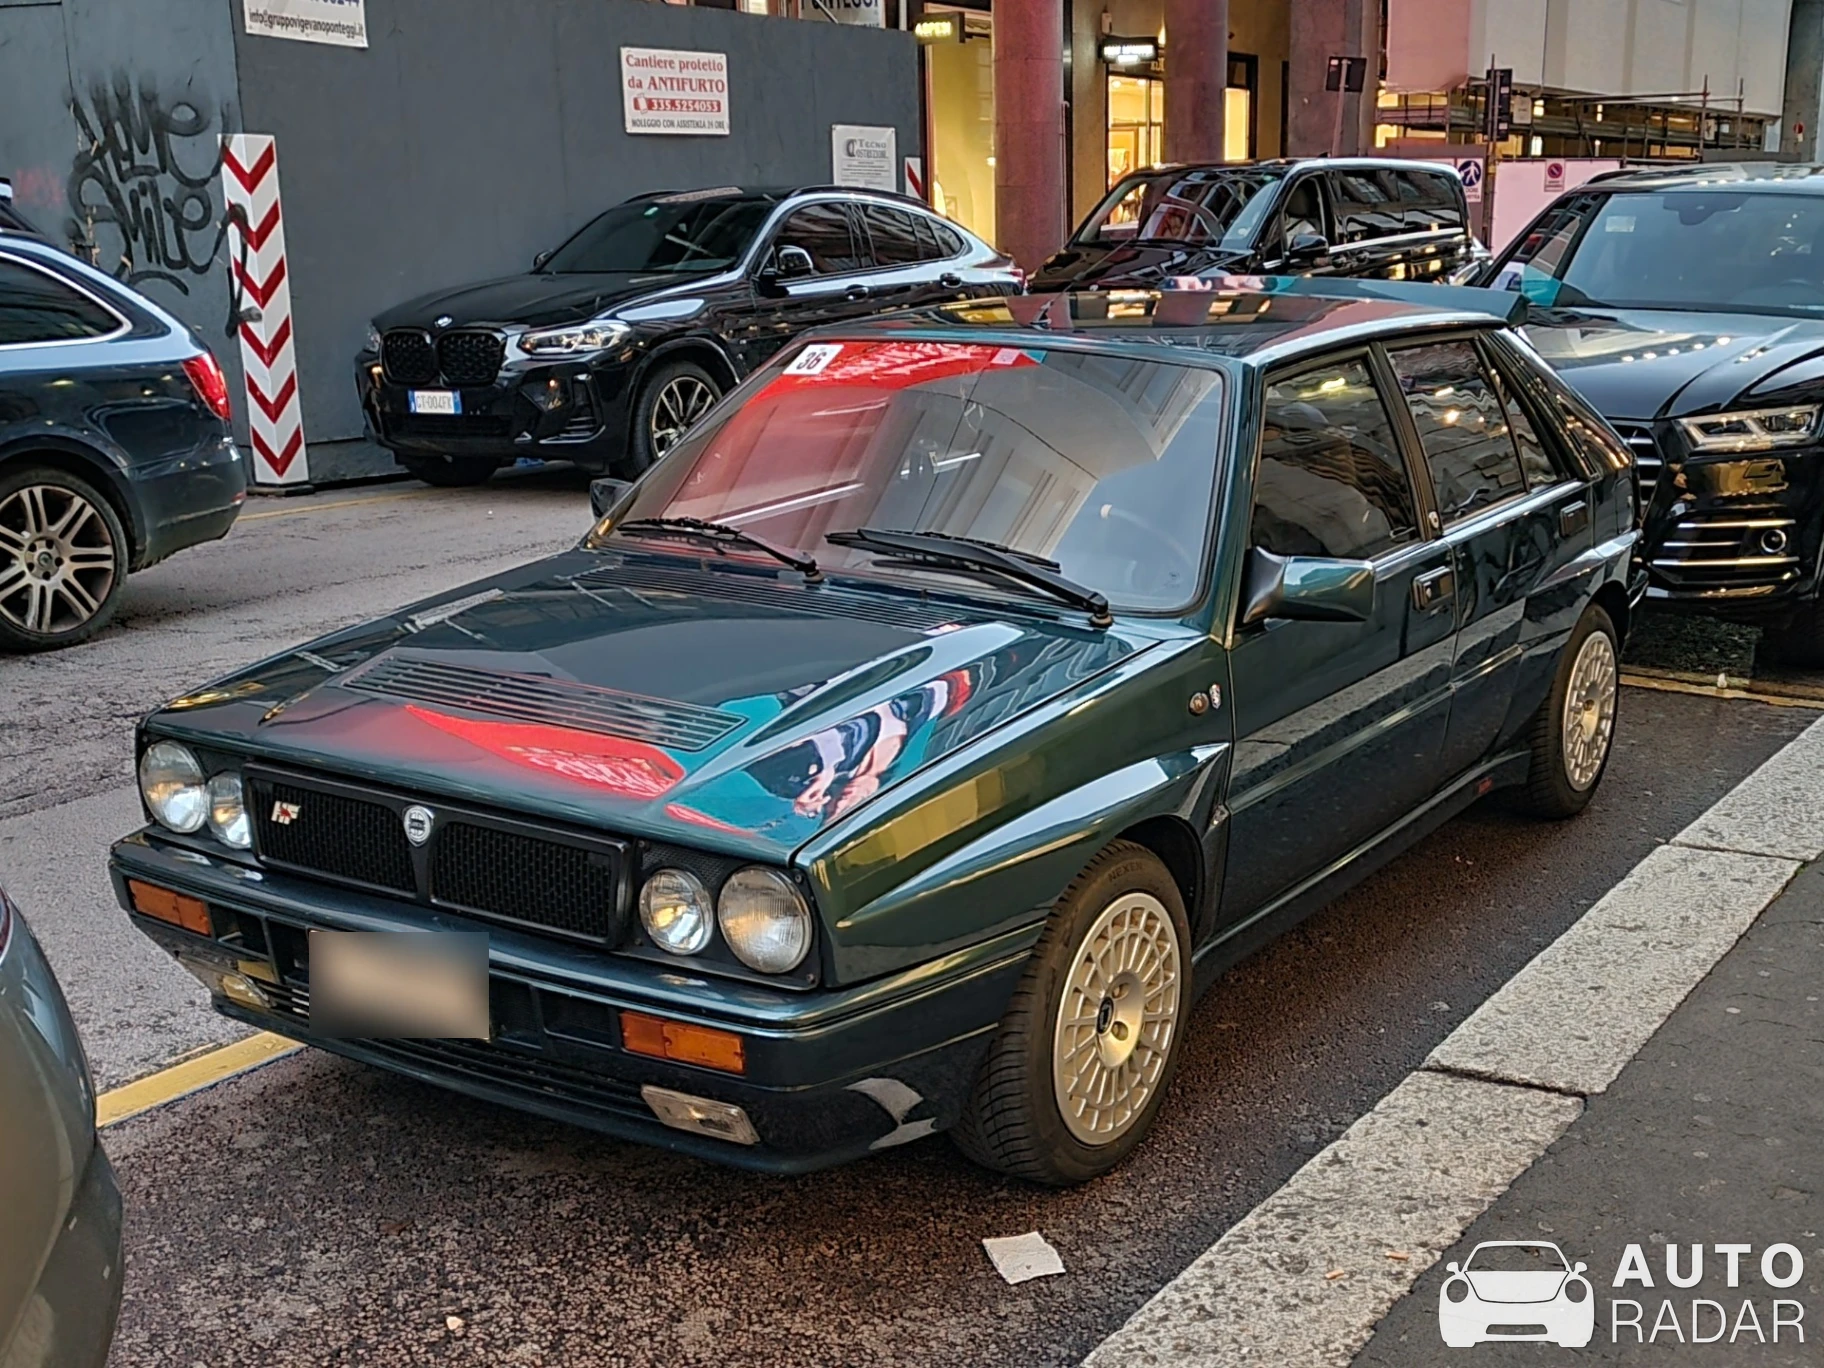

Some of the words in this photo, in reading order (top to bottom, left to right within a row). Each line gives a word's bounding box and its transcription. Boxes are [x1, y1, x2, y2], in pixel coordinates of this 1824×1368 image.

[625, 54, 675, 69] Cantiere
[679, 58, 723, 73] protetto
[627, 75, 643, 89] da
[647, 75, 725, 93] ANTIFURTO
[631, 118, 661, 129] NOLEGGIO
[662, 119, 676, 129] CON
[796, 351, 827, 370] 36
